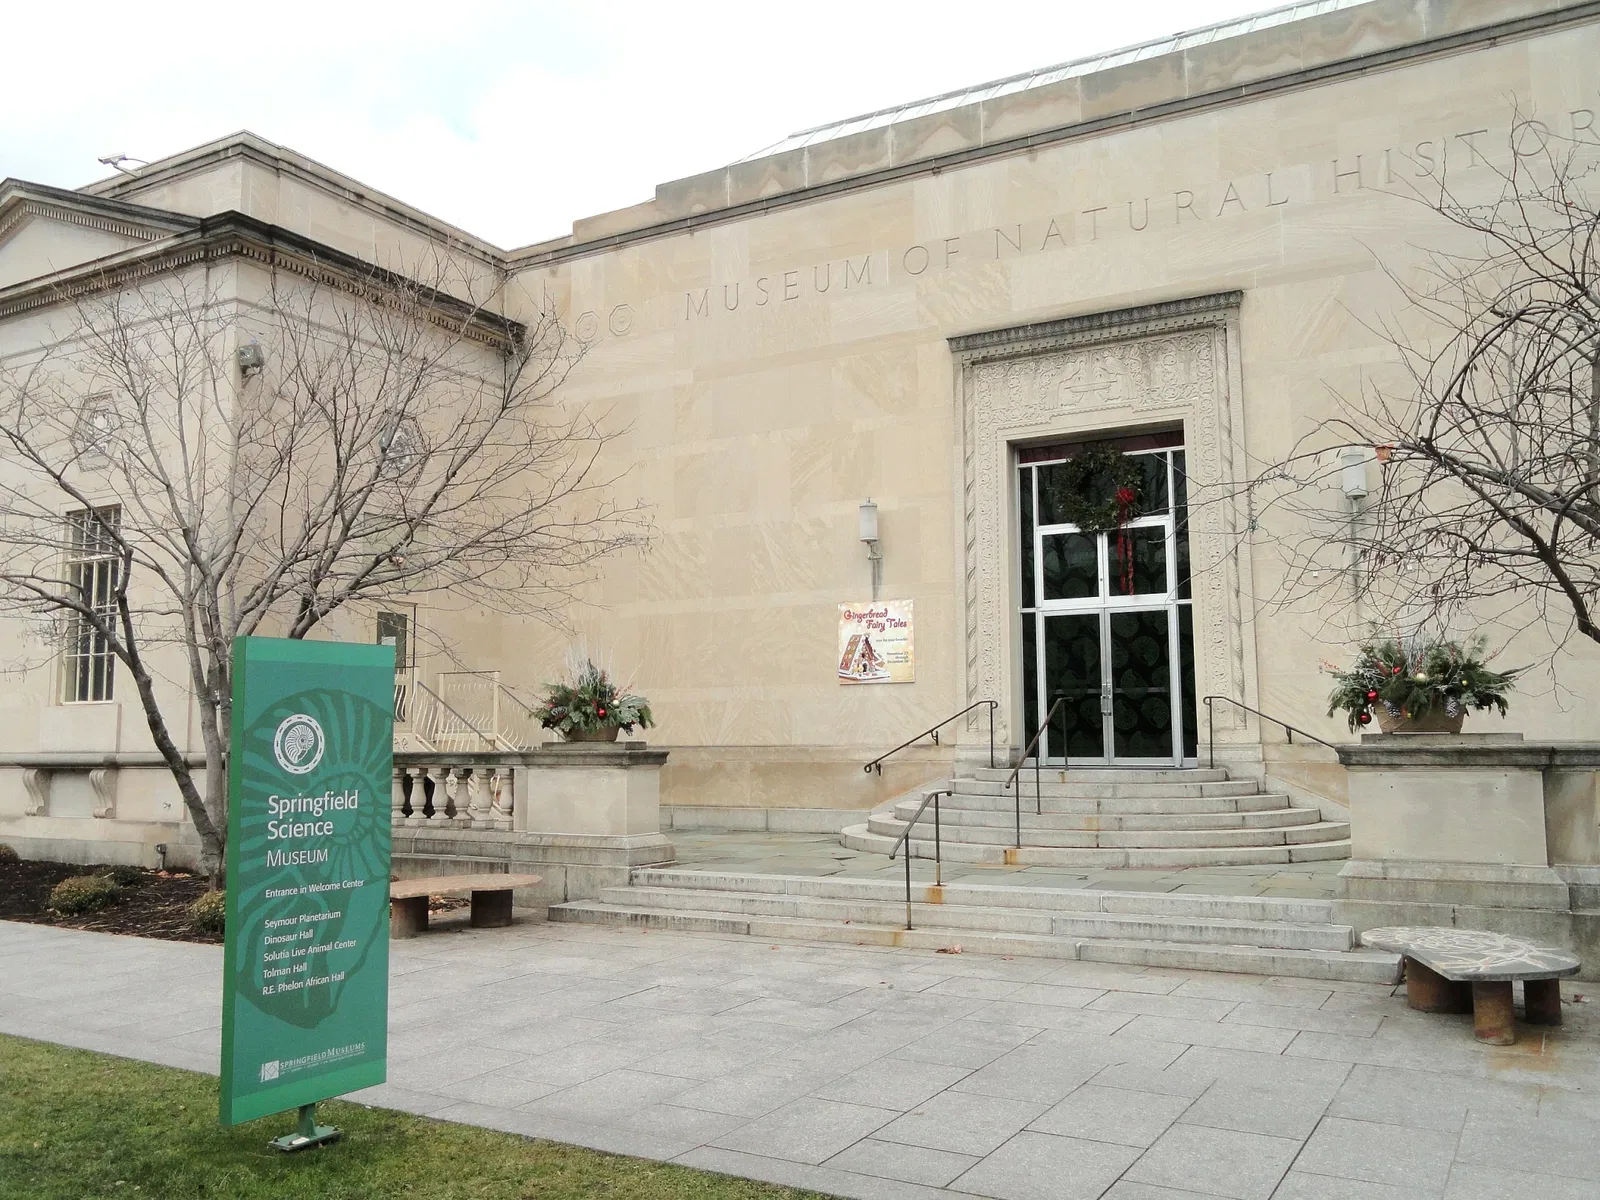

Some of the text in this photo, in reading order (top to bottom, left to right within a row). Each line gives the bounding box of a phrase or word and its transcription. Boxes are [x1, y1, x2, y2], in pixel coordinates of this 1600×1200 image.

[685, 255, 872, 321] MUSEUM
[902, 236, 960, 276] OF
[993, 172, 1289, 260] NATURAL
[843, 607, 888, 623] Gingerbread
[866, 618, 908, 633] Fairy Tales
[268, 790, 359, 819] Springfield
[267, 818, 333, 840] Science
[266, 848, 328, 867] MUSEUM
[265, 879, 364, 898] Entrance in Welcome Center
[264, 910, 341, 929] Seymour Planetarium
[264, 929, 314, 945] Dinosaur Hall
[263, 939, 357, 962] Solutia Live Animal Center
[263, 962, 307, 979] Tolman Hall
[262, 971, 345, 995] R.E. Phelon African Hall
